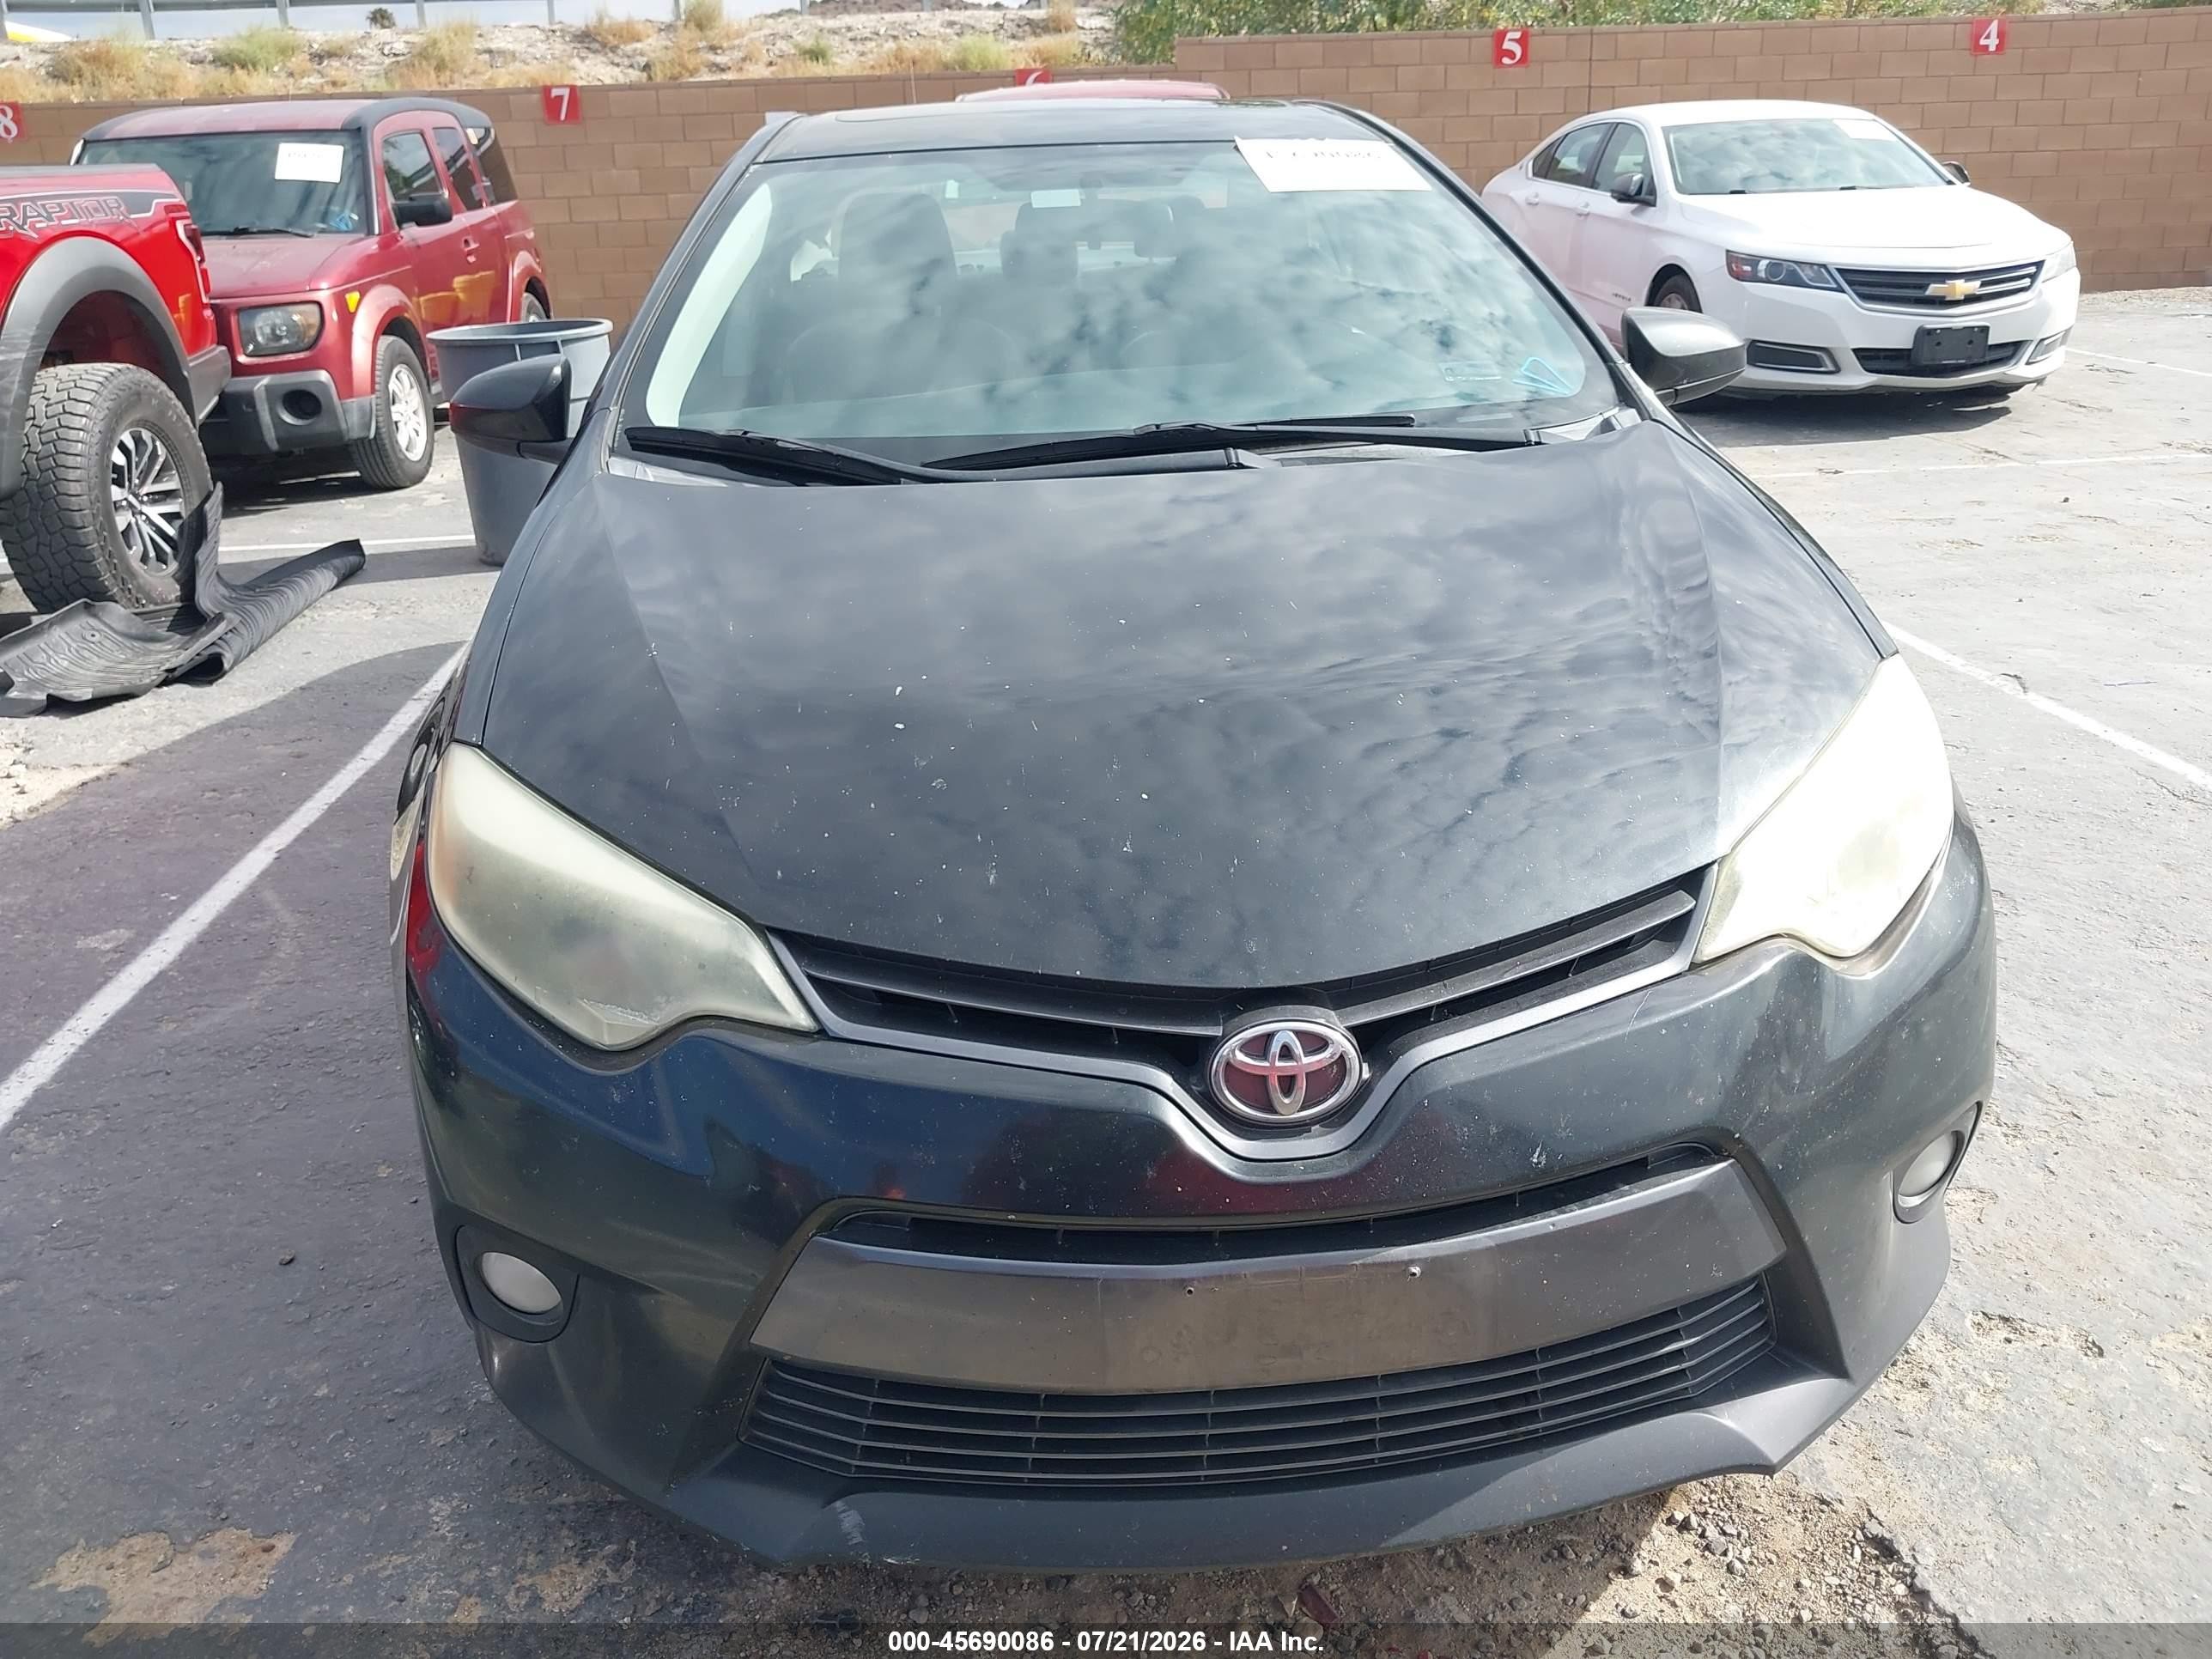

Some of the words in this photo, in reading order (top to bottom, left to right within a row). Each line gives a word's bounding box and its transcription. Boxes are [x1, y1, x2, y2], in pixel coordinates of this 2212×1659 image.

[1501, 31, 1522, 65] 5
[1979, 19, 1999, 52] 4
[550, 87, 571, 121] 7
[0, 105, 18, 138] 8
[0, 196, 136, 238] RAPTOR
